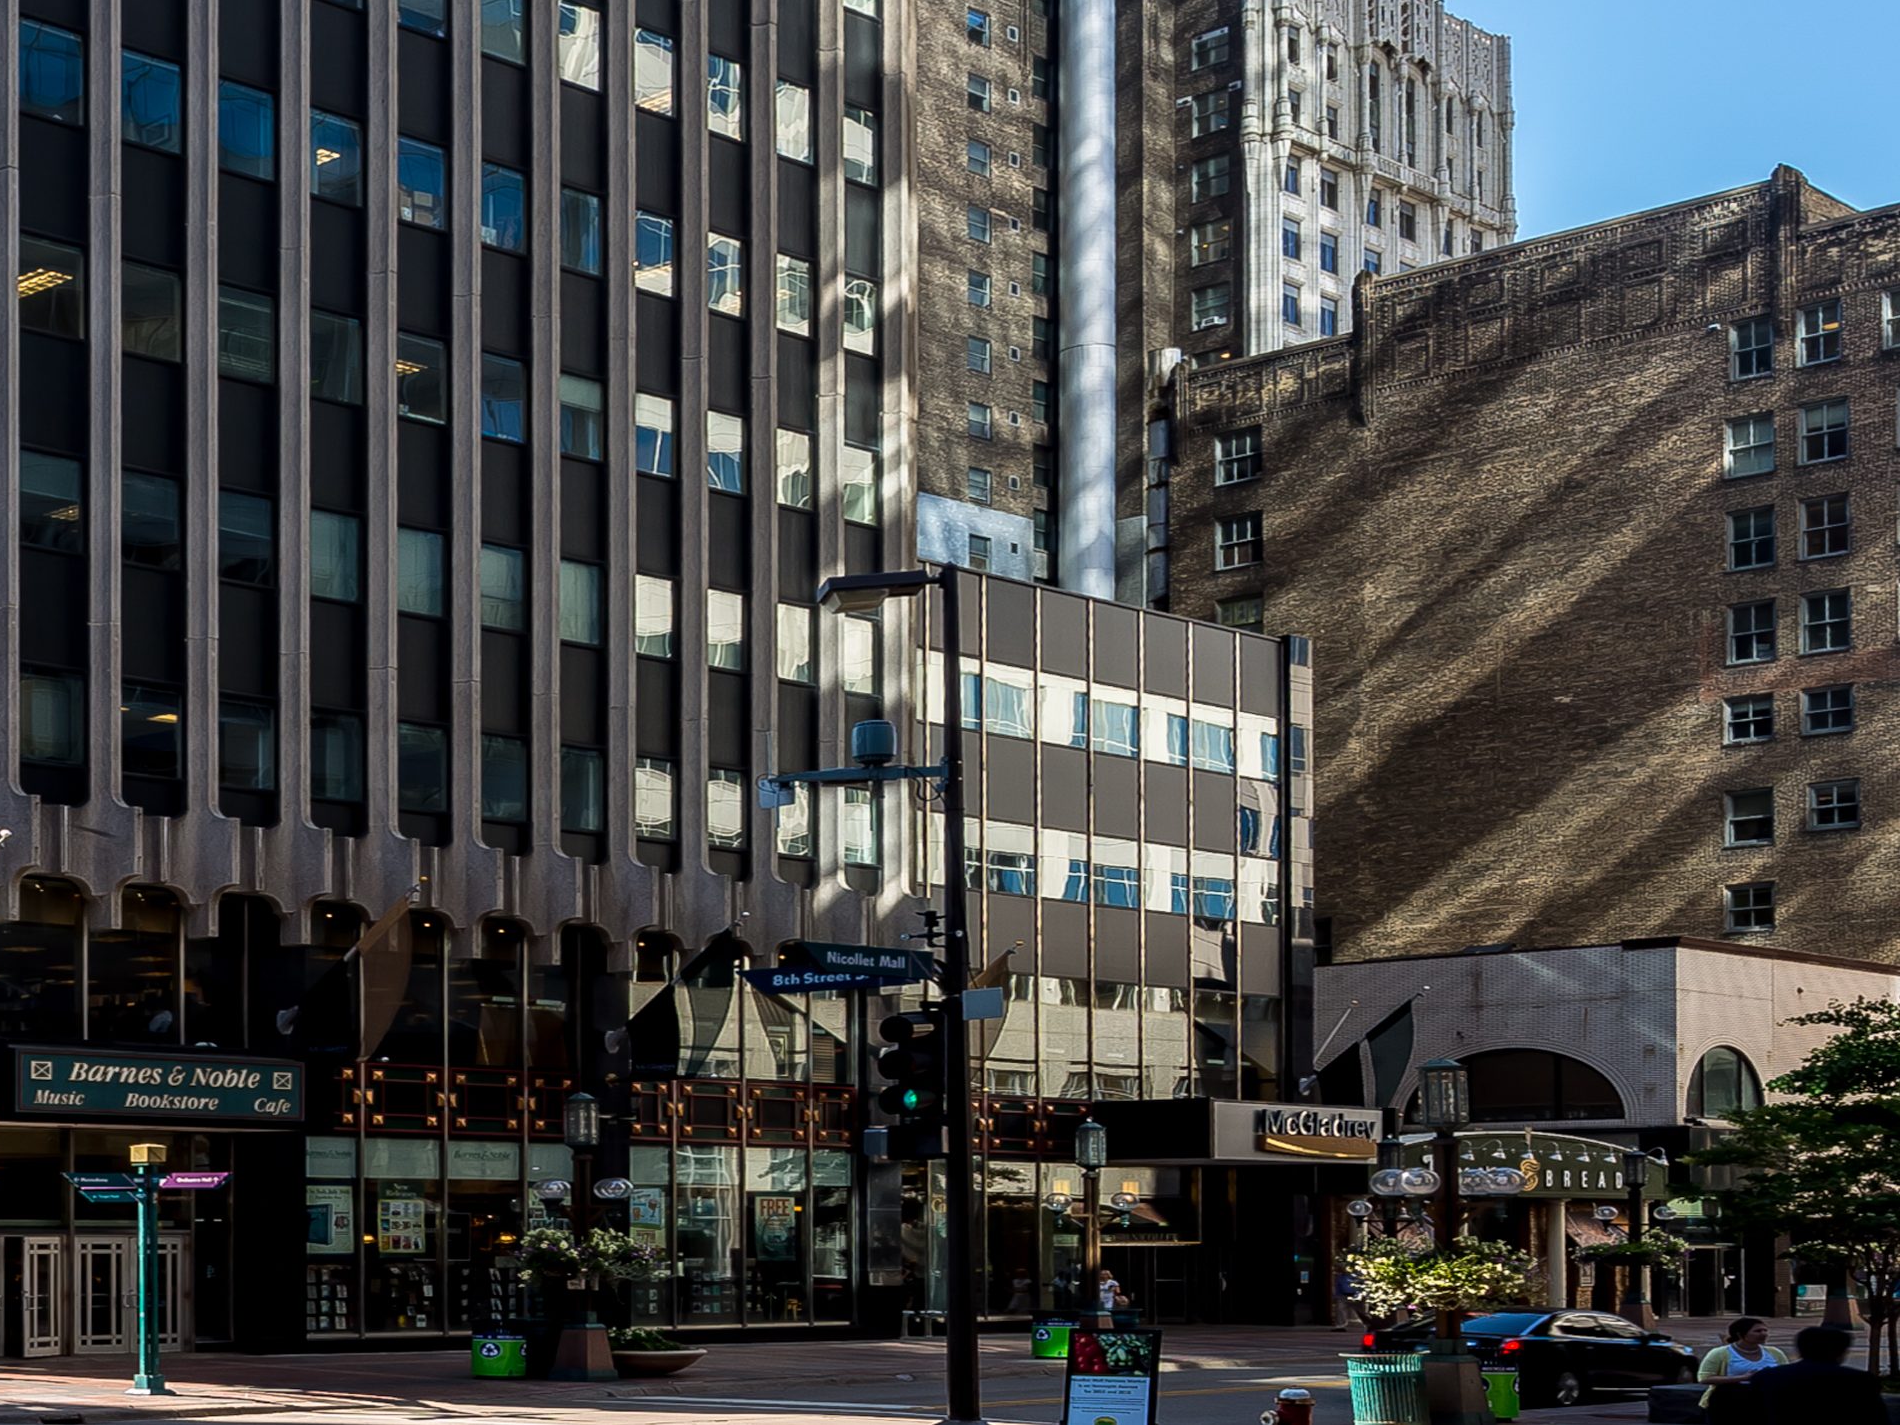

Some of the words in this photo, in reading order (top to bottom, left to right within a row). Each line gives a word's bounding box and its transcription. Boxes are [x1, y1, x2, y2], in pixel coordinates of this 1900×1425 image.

[826, 951, 874, 967] Nicollet
[879, 955, 905, 969] Mall
[772, 973, 799, 987] 8th
[803, 972, 851, 984] Street
[68, 1062, 162, 1085] Barnes
[167, 1066, 186, 1087] &
[190, 1068, 261, 1089] Noble
[34, 1090, 85, 1105] Music
[124, 1093, 219, 1110] Bookstore
[253, 1098, 291, 1115] Cafe
[1265, 1109, 1377, 1142] McGladrey
[1545, 1168, 1625, 1191] BREAD
[760, 1198, 790, 1217] FREE
